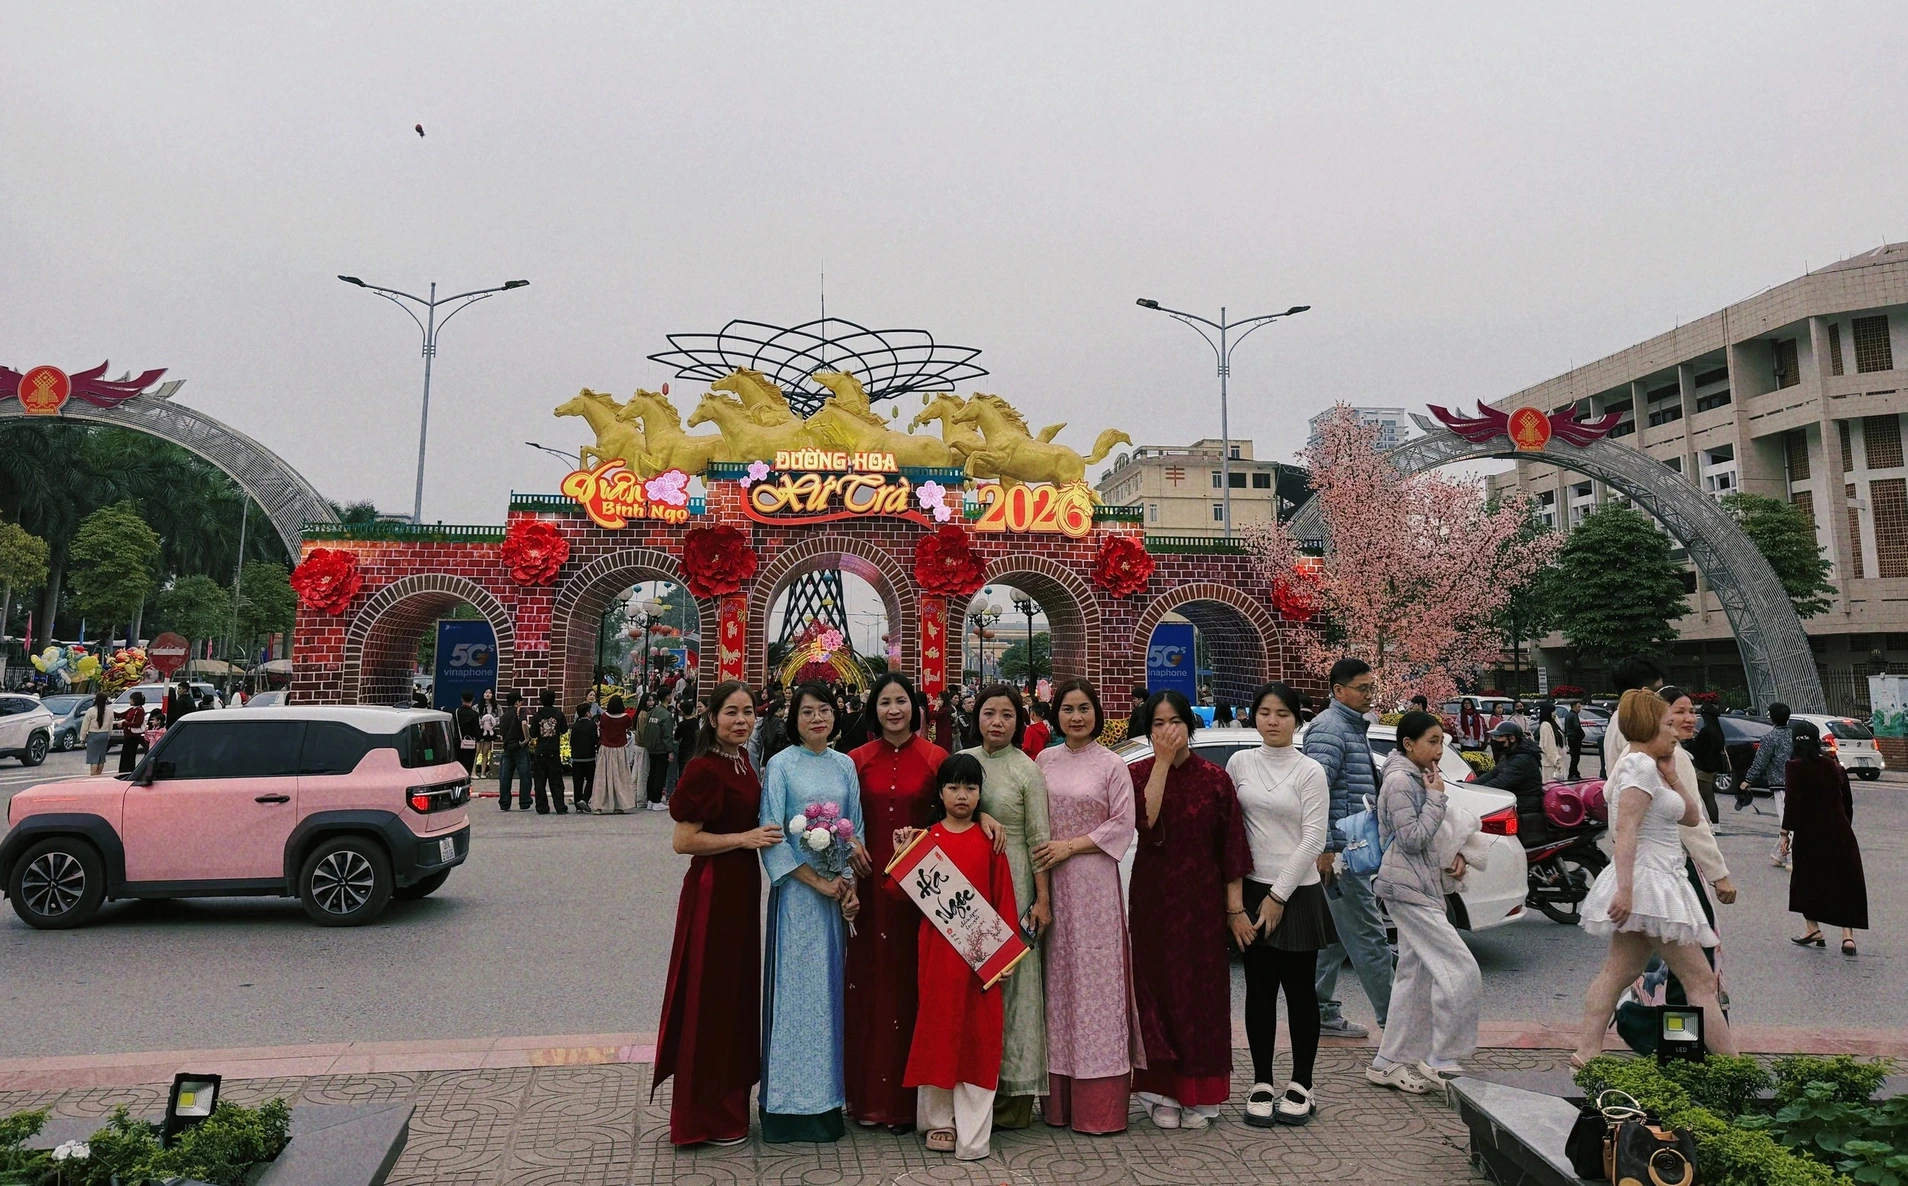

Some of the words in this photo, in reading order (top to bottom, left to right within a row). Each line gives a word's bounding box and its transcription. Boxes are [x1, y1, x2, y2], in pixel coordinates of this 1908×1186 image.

[775, 448, 847, 471] ĐƯỜNG
[854, 452, 898, 471] HOA
[752, 473, 837, 513] Xứ
[836, 473, 911, 513] Trà
[650, 504, 688, 523] Ngọ
[975, 479, 1093, 538] 2026
[443, 667, 493, 678] vinaphone
[1147, 668, 1188, 678] inaphone
